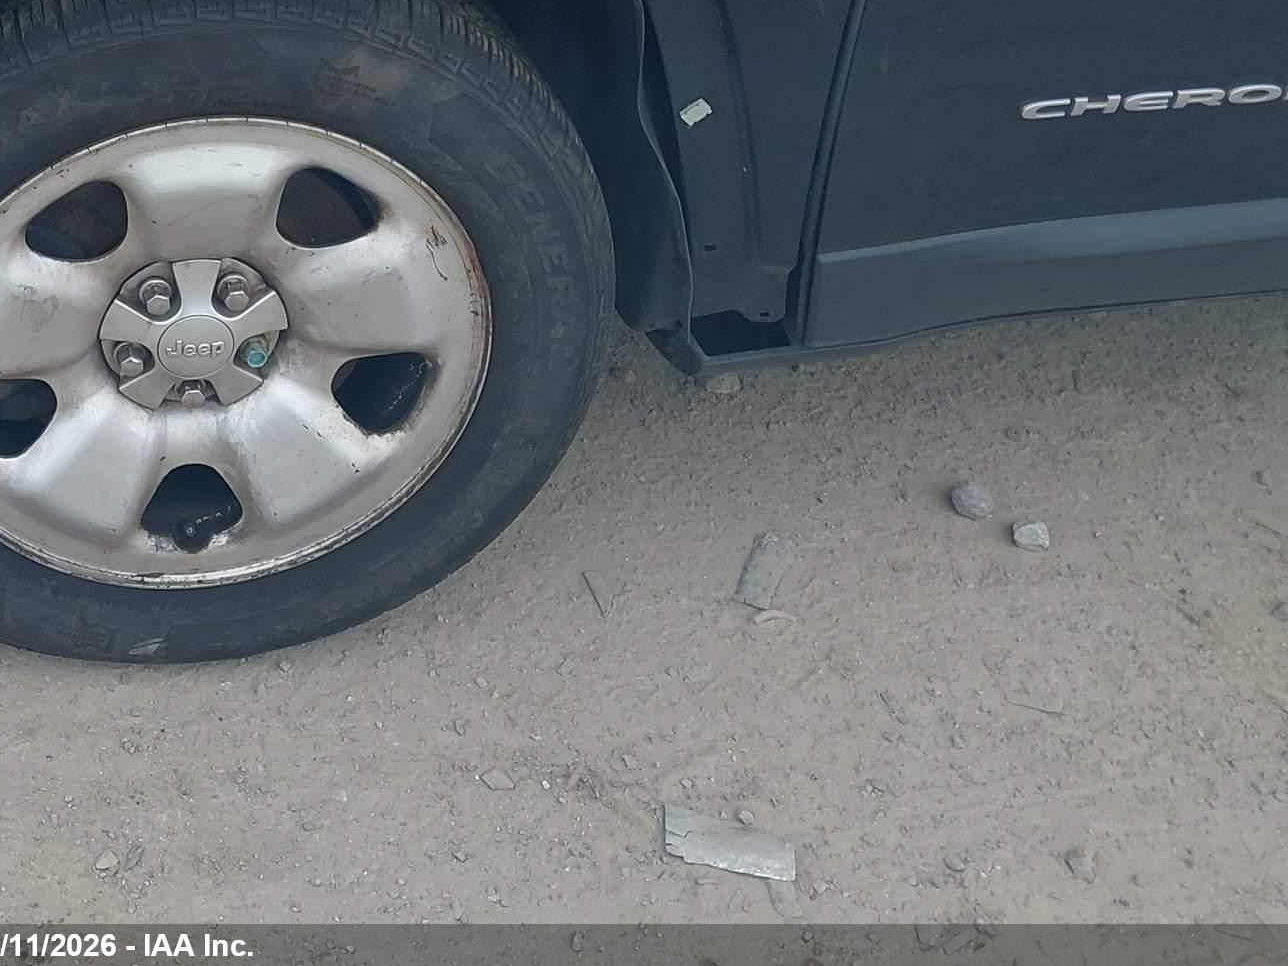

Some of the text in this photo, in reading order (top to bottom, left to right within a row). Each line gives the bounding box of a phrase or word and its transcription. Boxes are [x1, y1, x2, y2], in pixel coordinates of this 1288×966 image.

[1021, 83, 1288, 120] CHERO
[482, 151, 574, 371] GENERAL
[166, 339, 225, 359] Jeep
